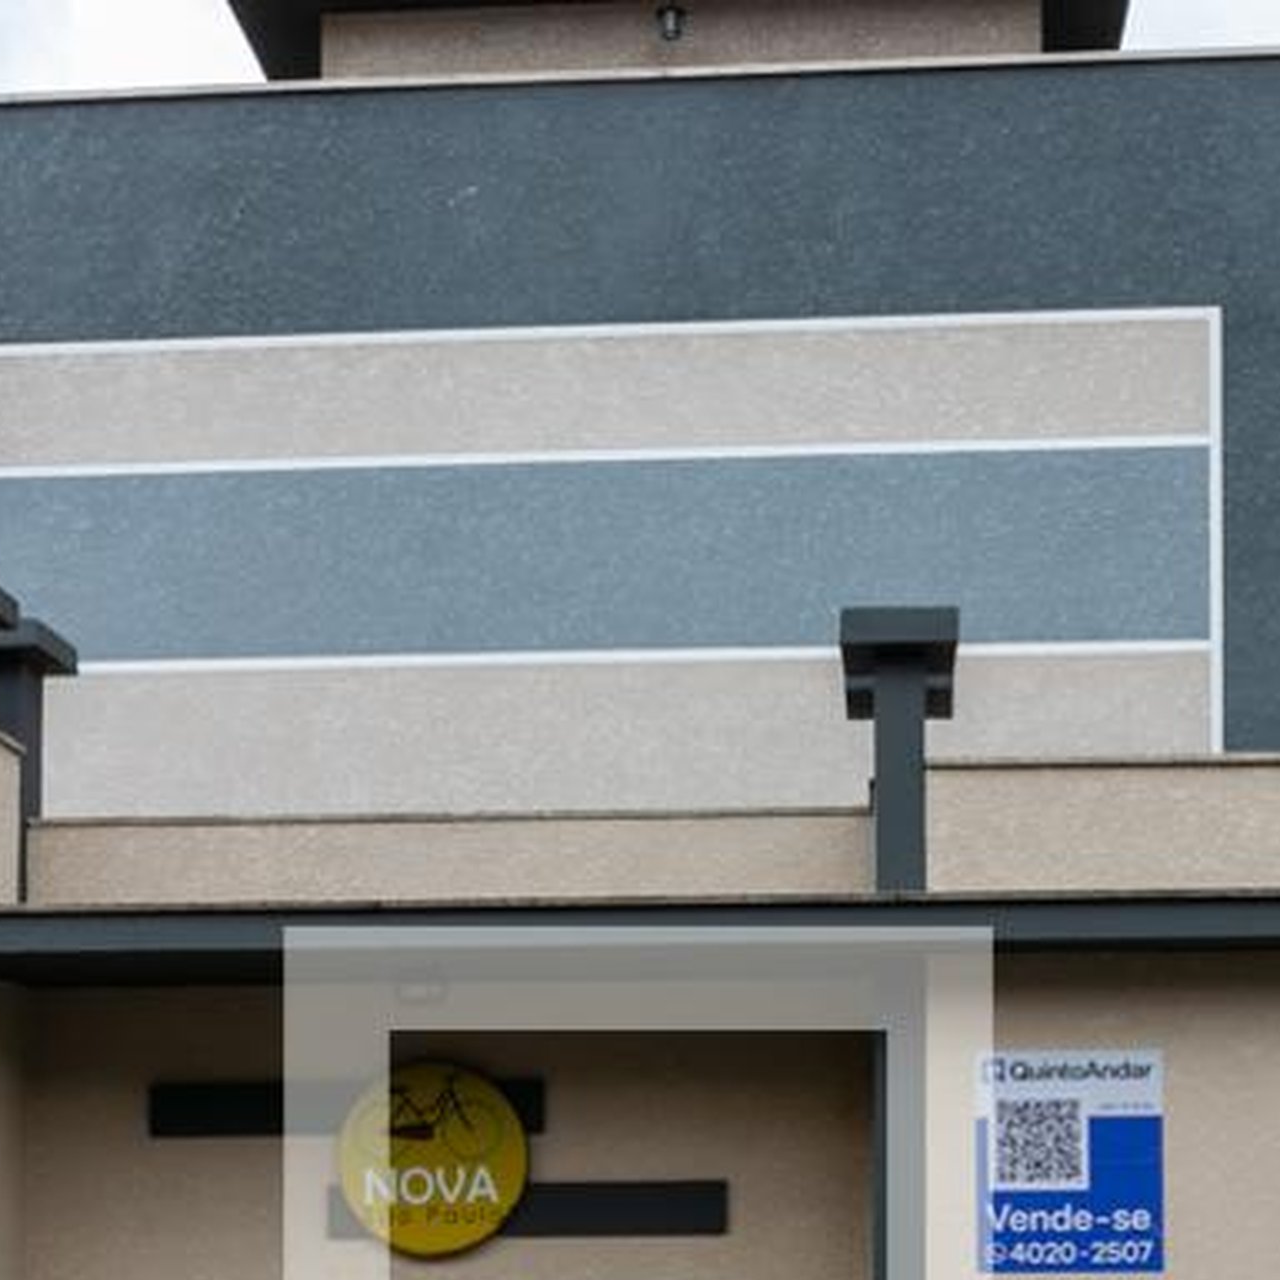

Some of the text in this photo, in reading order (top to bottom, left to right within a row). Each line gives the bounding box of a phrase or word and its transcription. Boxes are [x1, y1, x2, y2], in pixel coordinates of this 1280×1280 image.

[1009, 1060, 1151, 1081] QuintoAndar
[364, 1166, 499, 1205] NOVA
[987, 1203, 1152, 1232] Vende-se
[1009, 1240, 1154, 1265] 4020-2507
